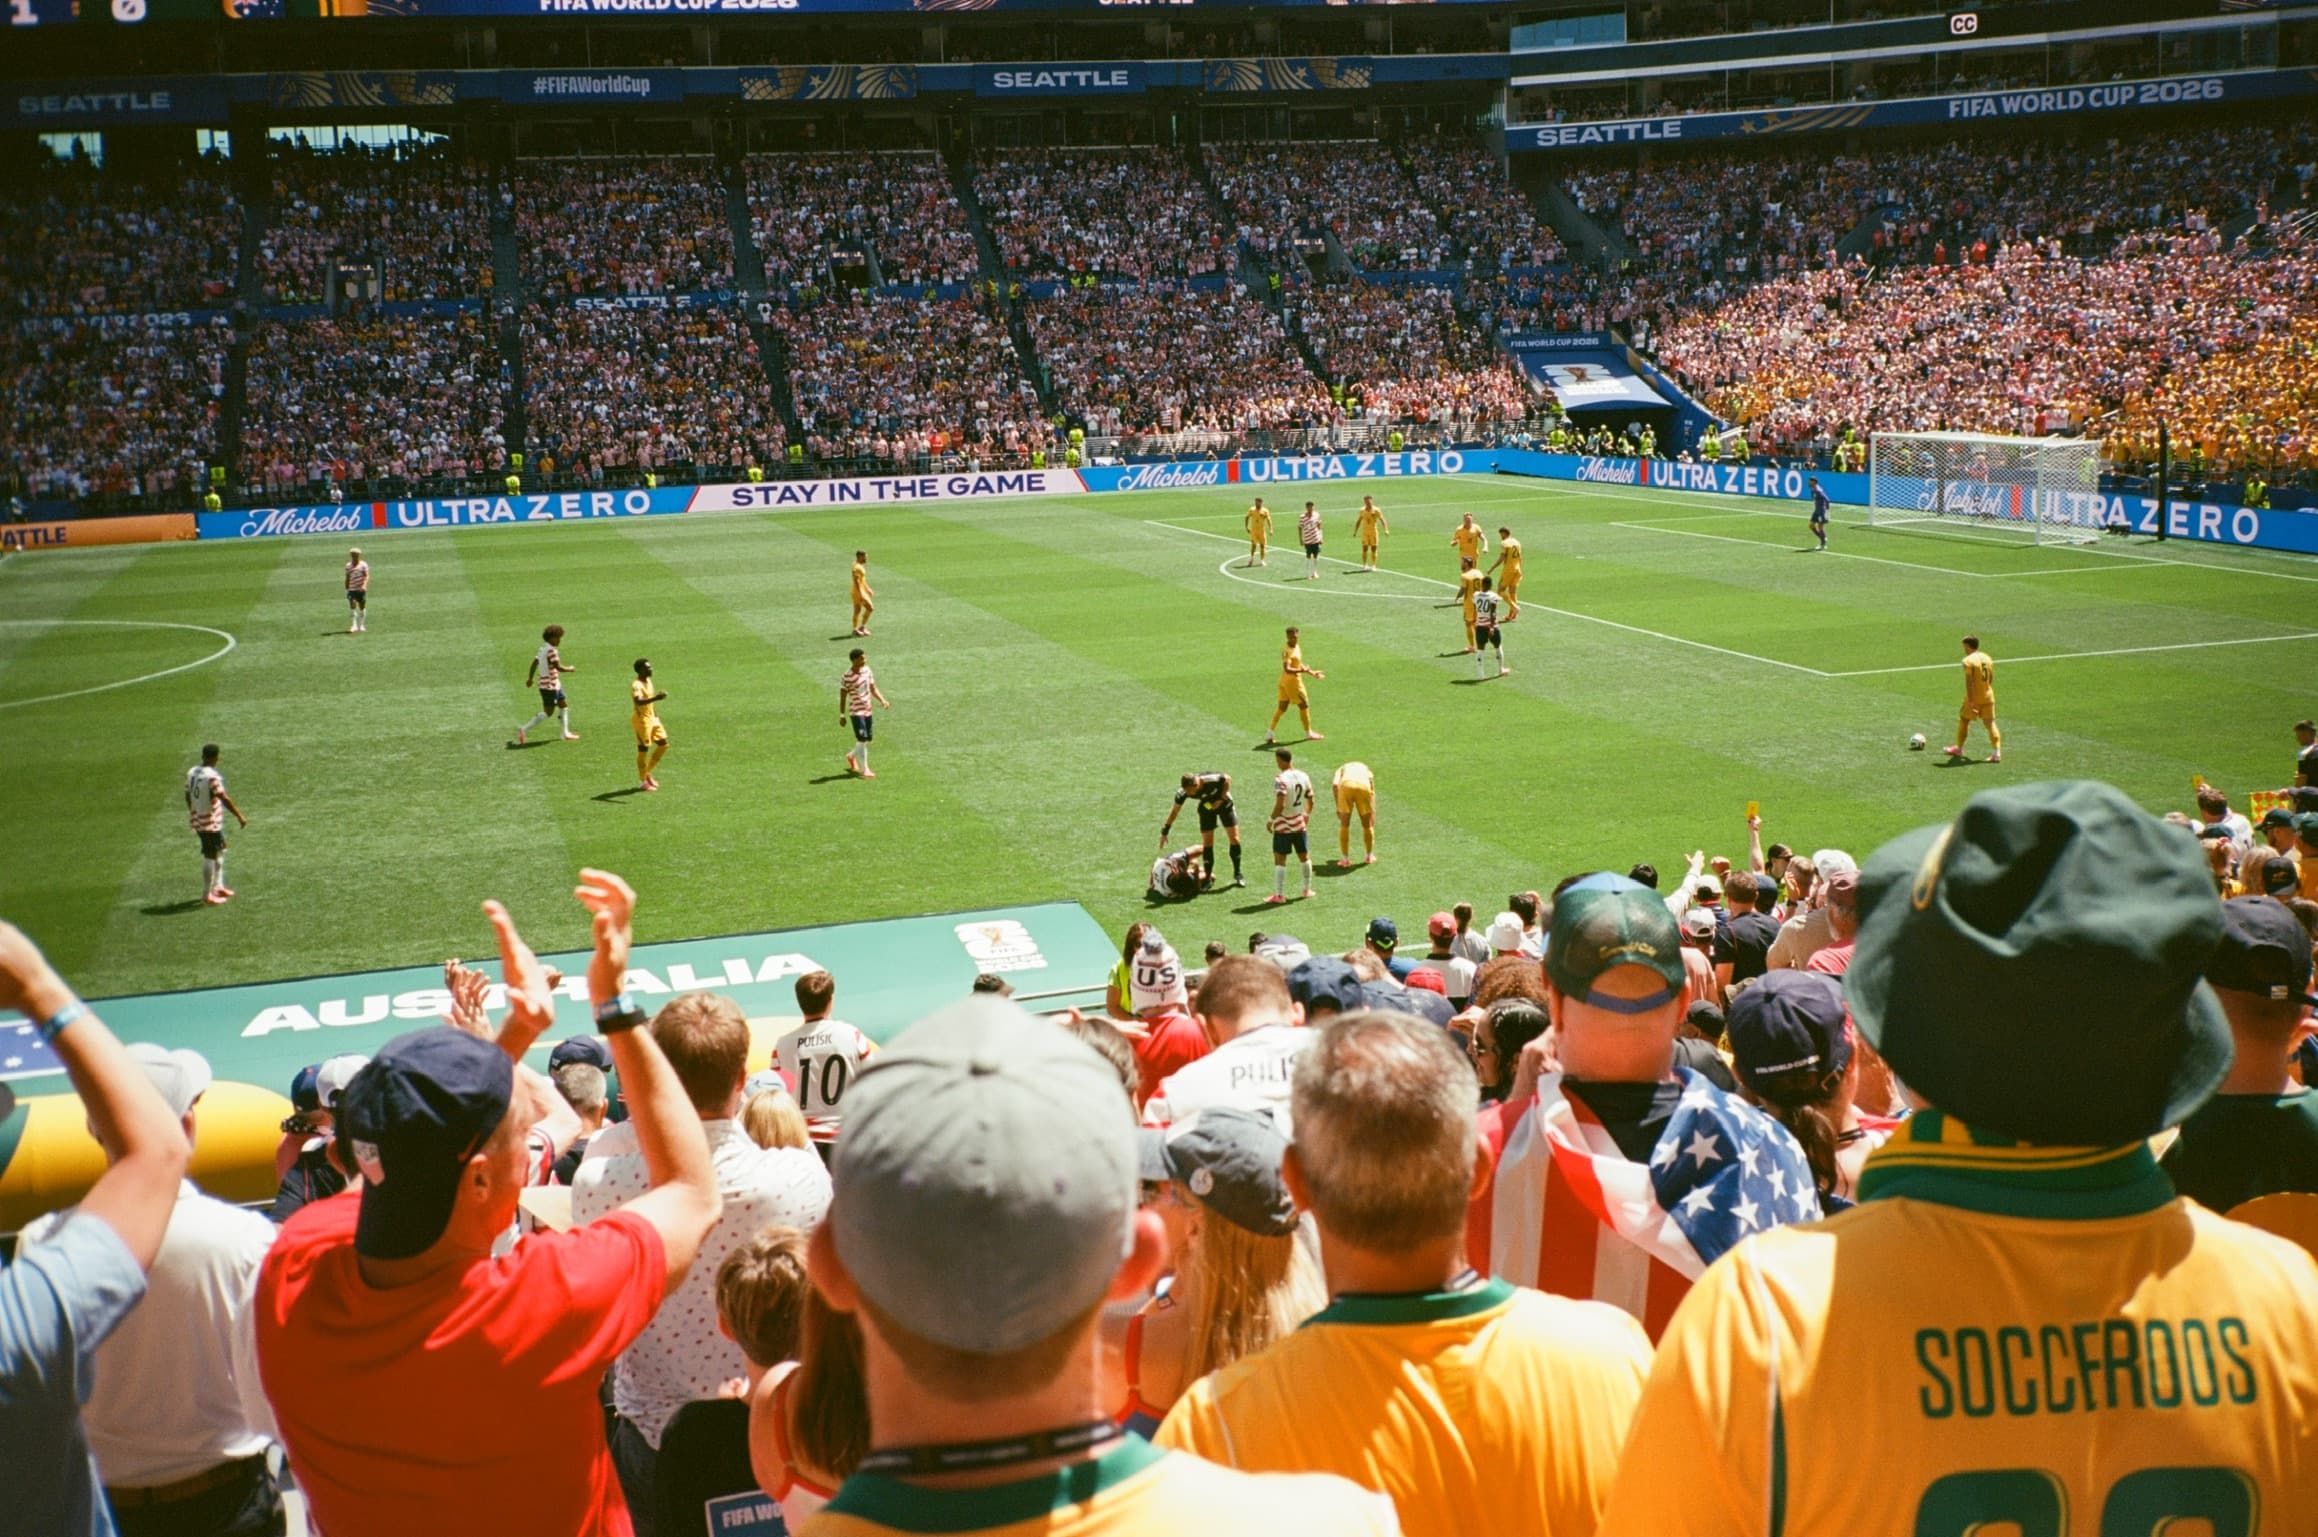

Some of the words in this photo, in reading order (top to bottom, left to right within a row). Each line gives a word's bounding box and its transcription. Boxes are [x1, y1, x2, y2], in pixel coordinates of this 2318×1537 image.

[9, 0, 39, 25] 1
[111, 0, 147, 22] 0
[1953, 16, 1975, 32] CC
[533, 74, 650, 96] #FIFAWorldCup
[993, 70, 1128, 88] SEATTLE
[19, 92, 170, 113] SEATTLE
[1949, 97, 1997, 118] FIFA
[2002, 89, 2084, 115] WORLD
[2089, 85, 2135, 108] CUP
[2140, 79, 2224, 103] 2026
[1536, 121, 1682, 147] SEATTLE
[1528, 338, 1555, 347] WORLD
[1556, 338, 1571, 346] CUP
[1118, 461, 1218, 491] Michelob
[1249, 454, 1346, 482] ULTRA
[1356, 451, 1464, 477] ZERO
[1575, 456, 1635, 485] Michelob
[1653, 460, 1718, 491] ULTRA
[1724, 466, 1803, 498] ZERO
[732, 484, 818, 507] STAY
[829, 482, 861, 502] IN
[870, 478, 939, 499] THE
[947, 473, 1046, 496] GAME
[240, 505, 361, 538] Michelob
[398, 497, 516, 527] ULTRA
[527, 490, 651, 520] ZERO
[2031, 489, 2129, 528] ULTRA
[2139, 499, 2260, 543] ZERO
[4, 526, 67, 546] ATTLE
[1476, 598, 1490, 614] 20
[1293, 783, 1303, 807] 2
[1137, 967, 1176, 987] US
[799, 1053, 847, 1111] 10
[1231, 1053, 1295, 1089] PULI
[1914, 1317, 2257, 1418] SOCCEROOS
[722, 1506, 755, 1528] FIFA
